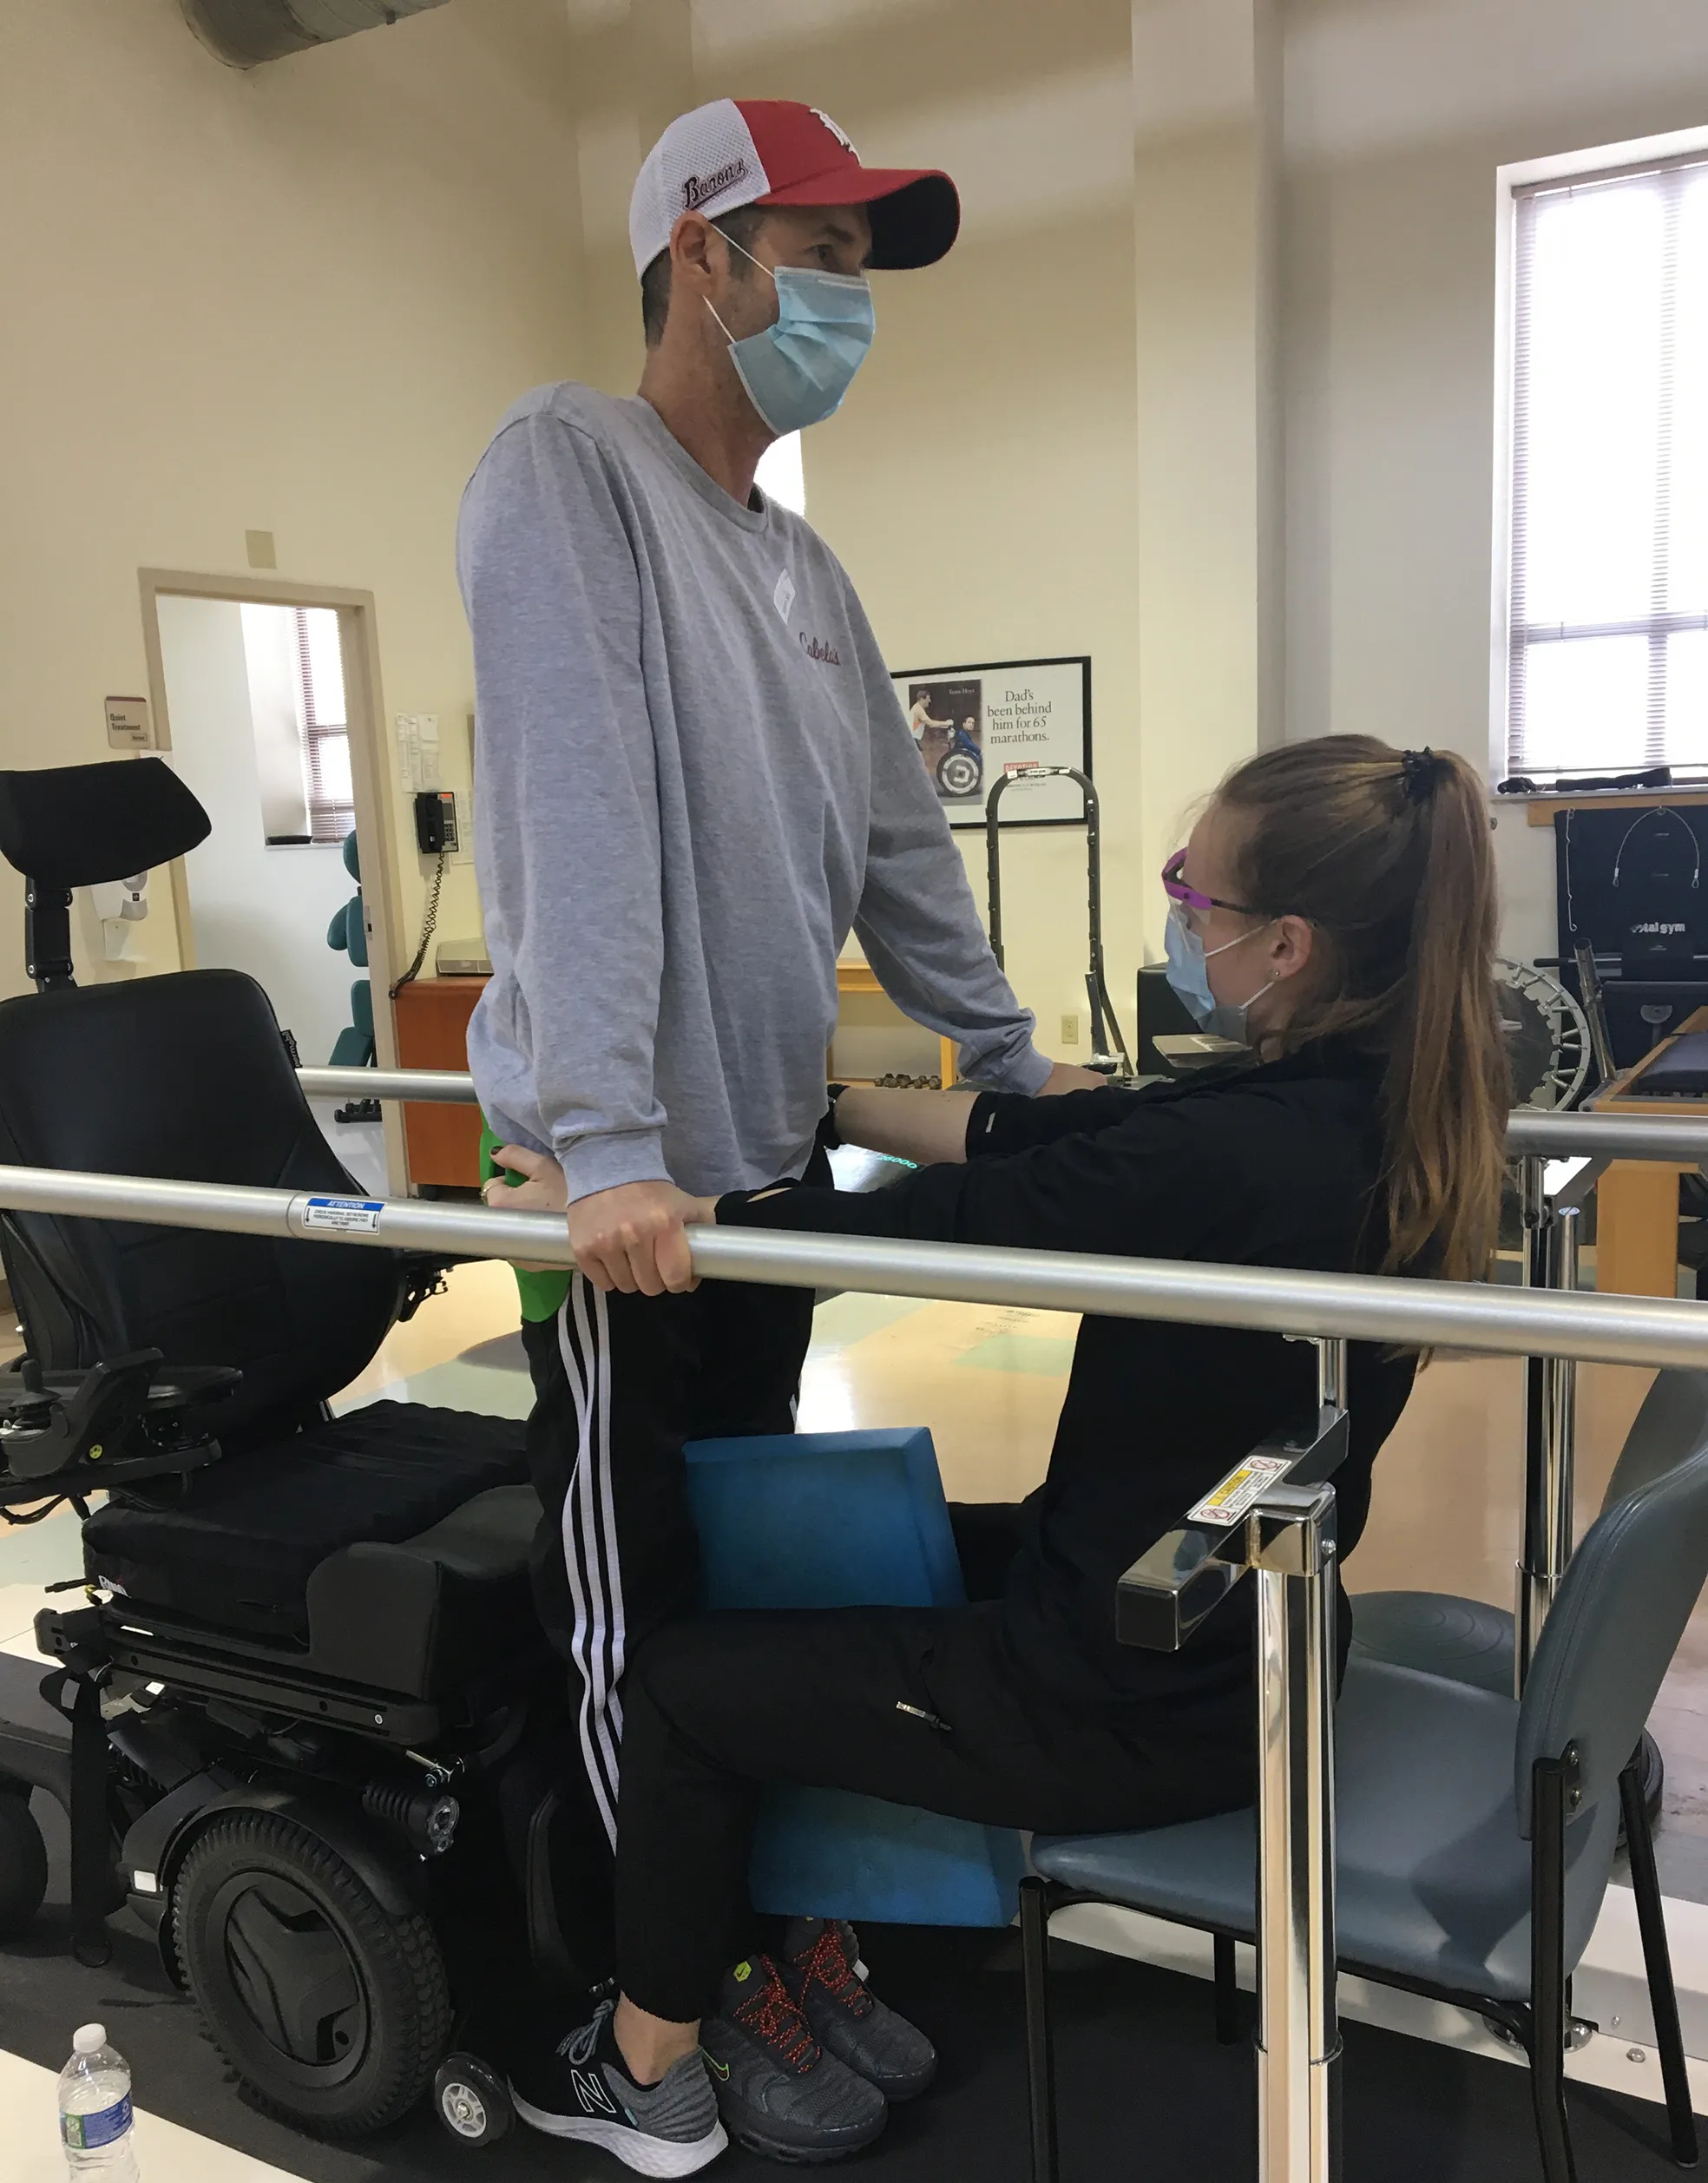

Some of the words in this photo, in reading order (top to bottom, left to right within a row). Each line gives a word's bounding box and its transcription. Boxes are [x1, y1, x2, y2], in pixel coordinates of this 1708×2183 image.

[683, 157, 747, 210] Barons
[798, 631, 841, 666] Cabela's
[1005, 689, 1034, 702] Dad's
[987, 705, 1013, 718] been
[1015, 701, 1052, 715] behind
[110, 713, 126, 721] Quiet
[992, 719, 1014, 731] him
[1015, 717, 1032, 729] for
[1033, 715, 1047, 728] 65
[990, 731, 1049, 744] marathons.
[1659, 923, 1685, 935] gym
[327, 1200, 366, 1209] ATTENTION
[569, 2068, 617, 2114] N
